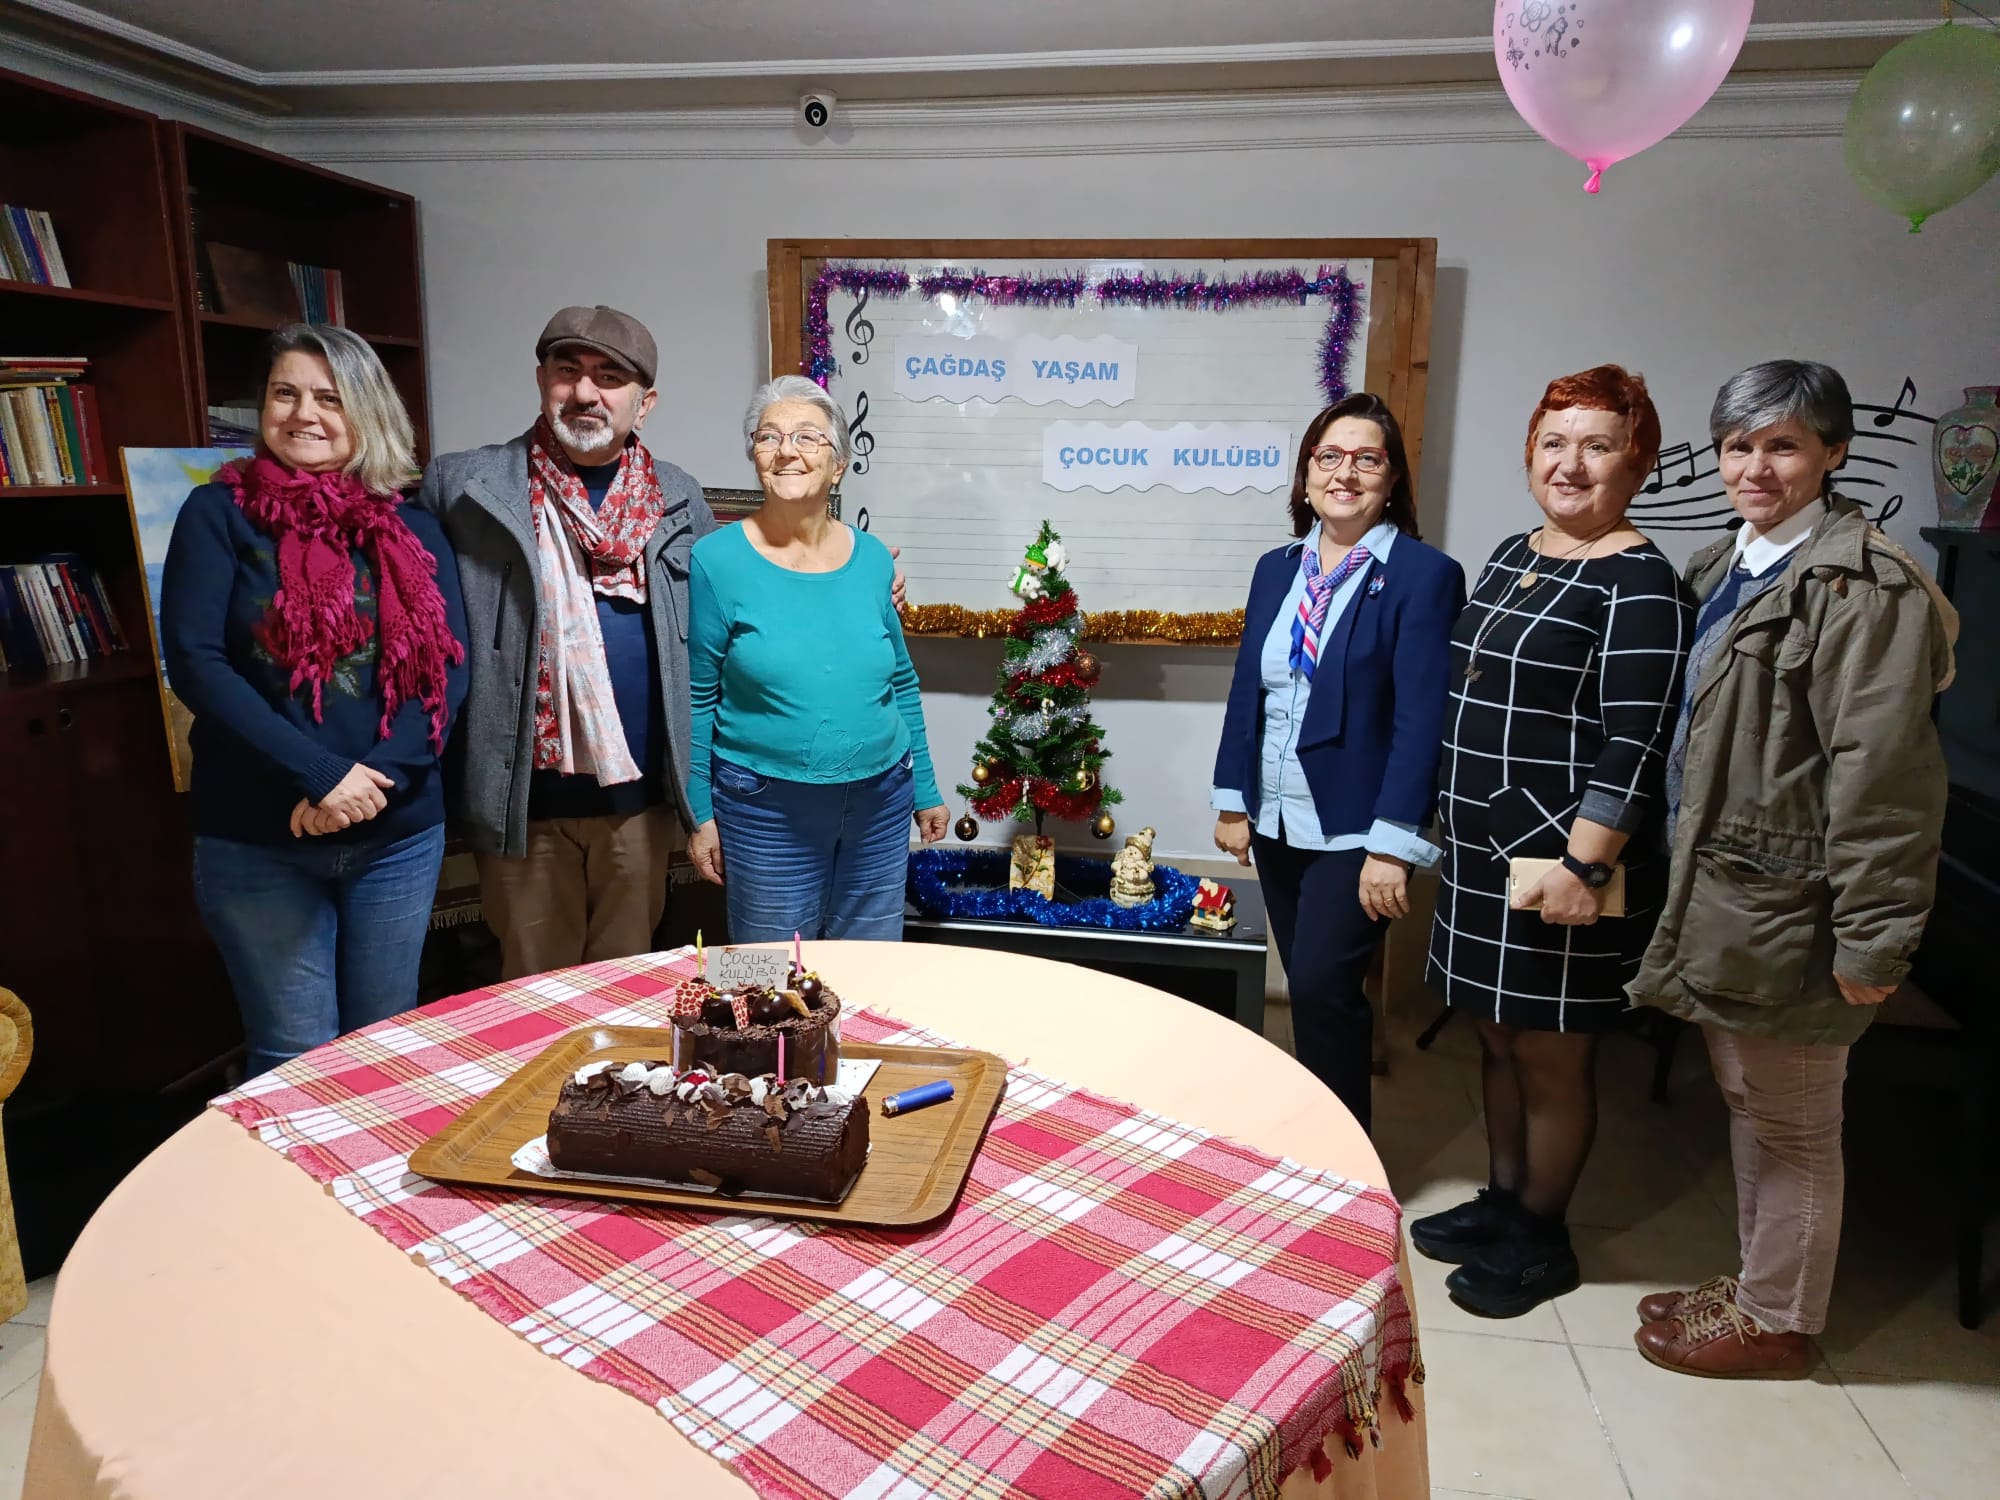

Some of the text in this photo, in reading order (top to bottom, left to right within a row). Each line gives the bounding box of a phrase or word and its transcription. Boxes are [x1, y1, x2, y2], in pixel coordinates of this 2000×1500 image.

[905, 353, 1119, 385] ÇAĞDAŞ YAŞAM
[1059, 445, 1281, 470] ÇOCUK KULÜBÜ
[720, 951, 780, 968] ÇOCUK
